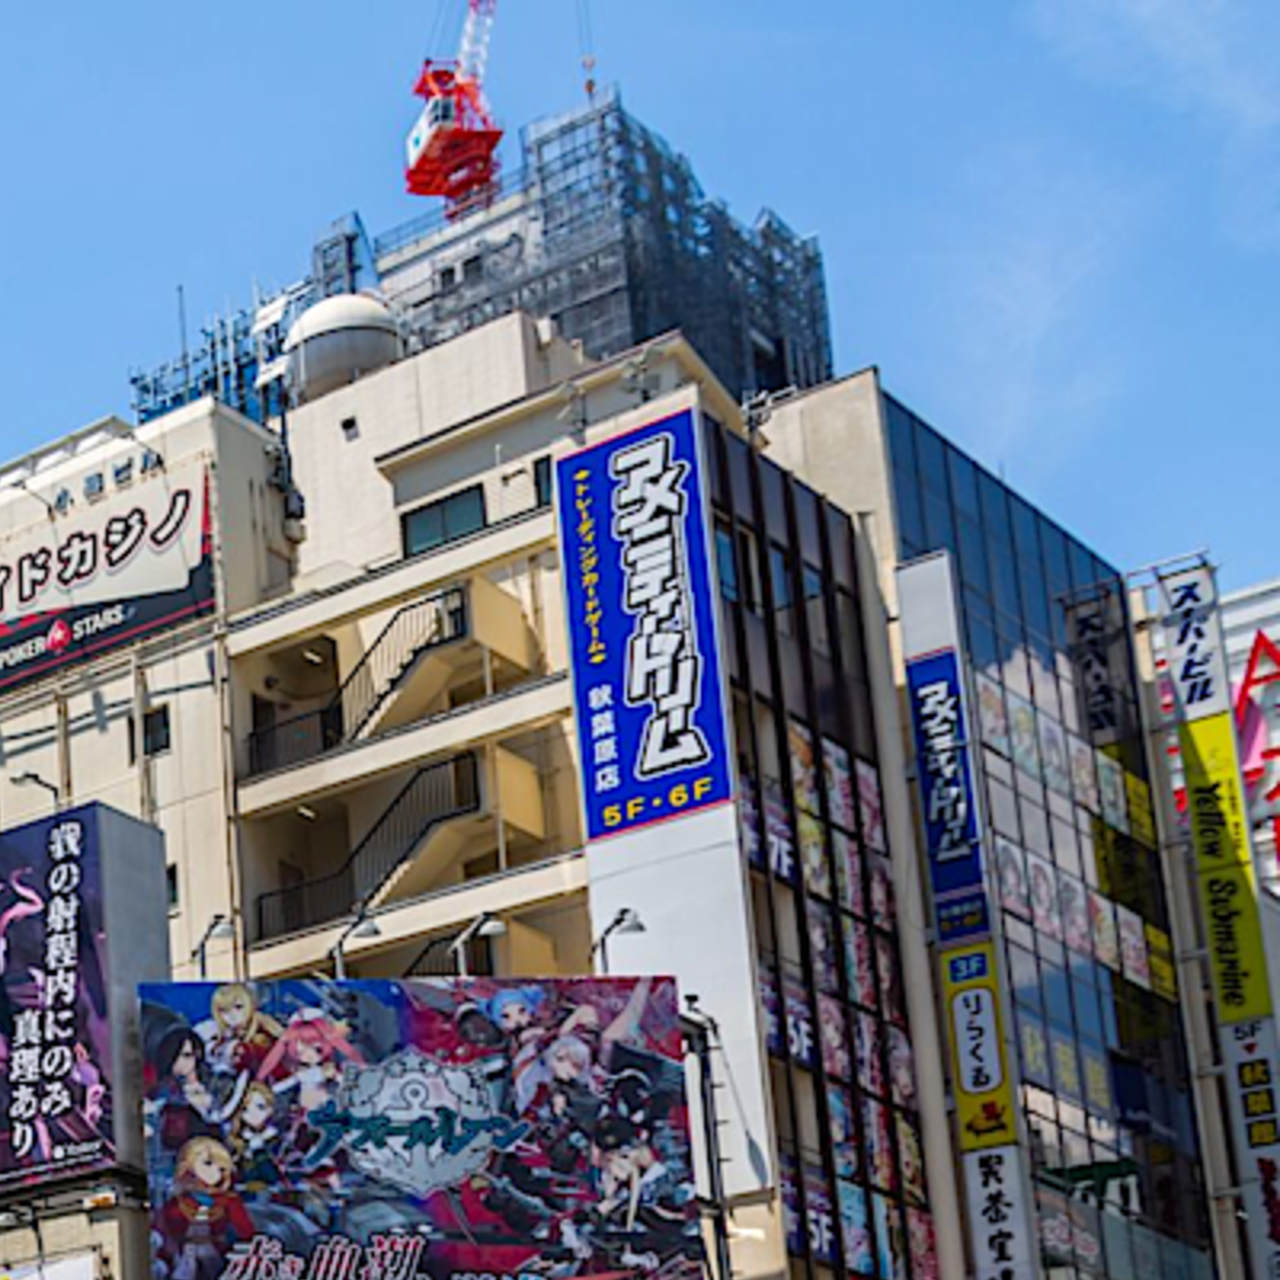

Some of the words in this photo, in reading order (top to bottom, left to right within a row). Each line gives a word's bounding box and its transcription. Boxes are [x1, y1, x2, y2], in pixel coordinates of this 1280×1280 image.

[72, 603, 124, 641] STARS
[587, 684, 622, 792] 秋葉原店
[8, 1008, 43, 1160] 真理あり
[963, 994, 992, 1089] りらくる
